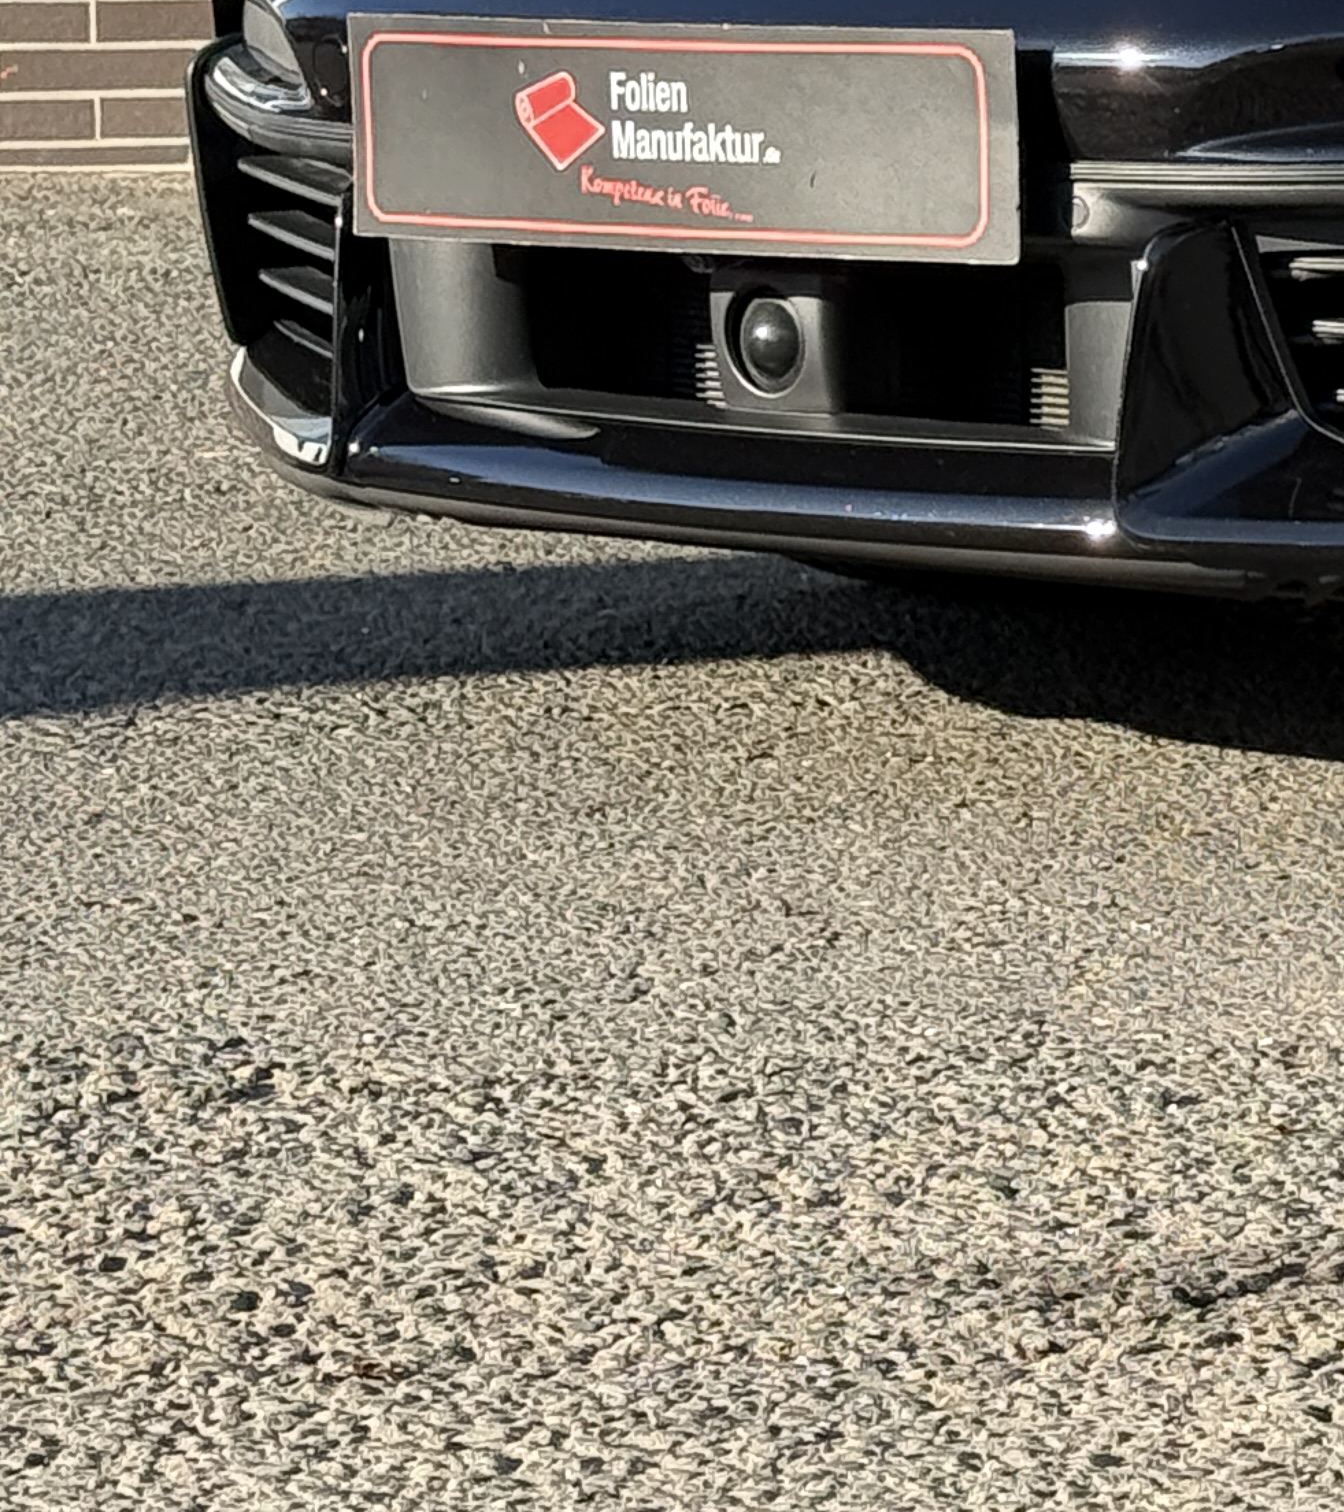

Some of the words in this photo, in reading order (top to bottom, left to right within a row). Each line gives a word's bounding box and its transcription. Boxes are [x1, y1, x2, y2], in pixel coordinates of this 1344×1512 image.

[609, 70, 689, 113] Folien
[579, 164, 665, 206] Kompetenz
[667, 186, 683, 210] in
